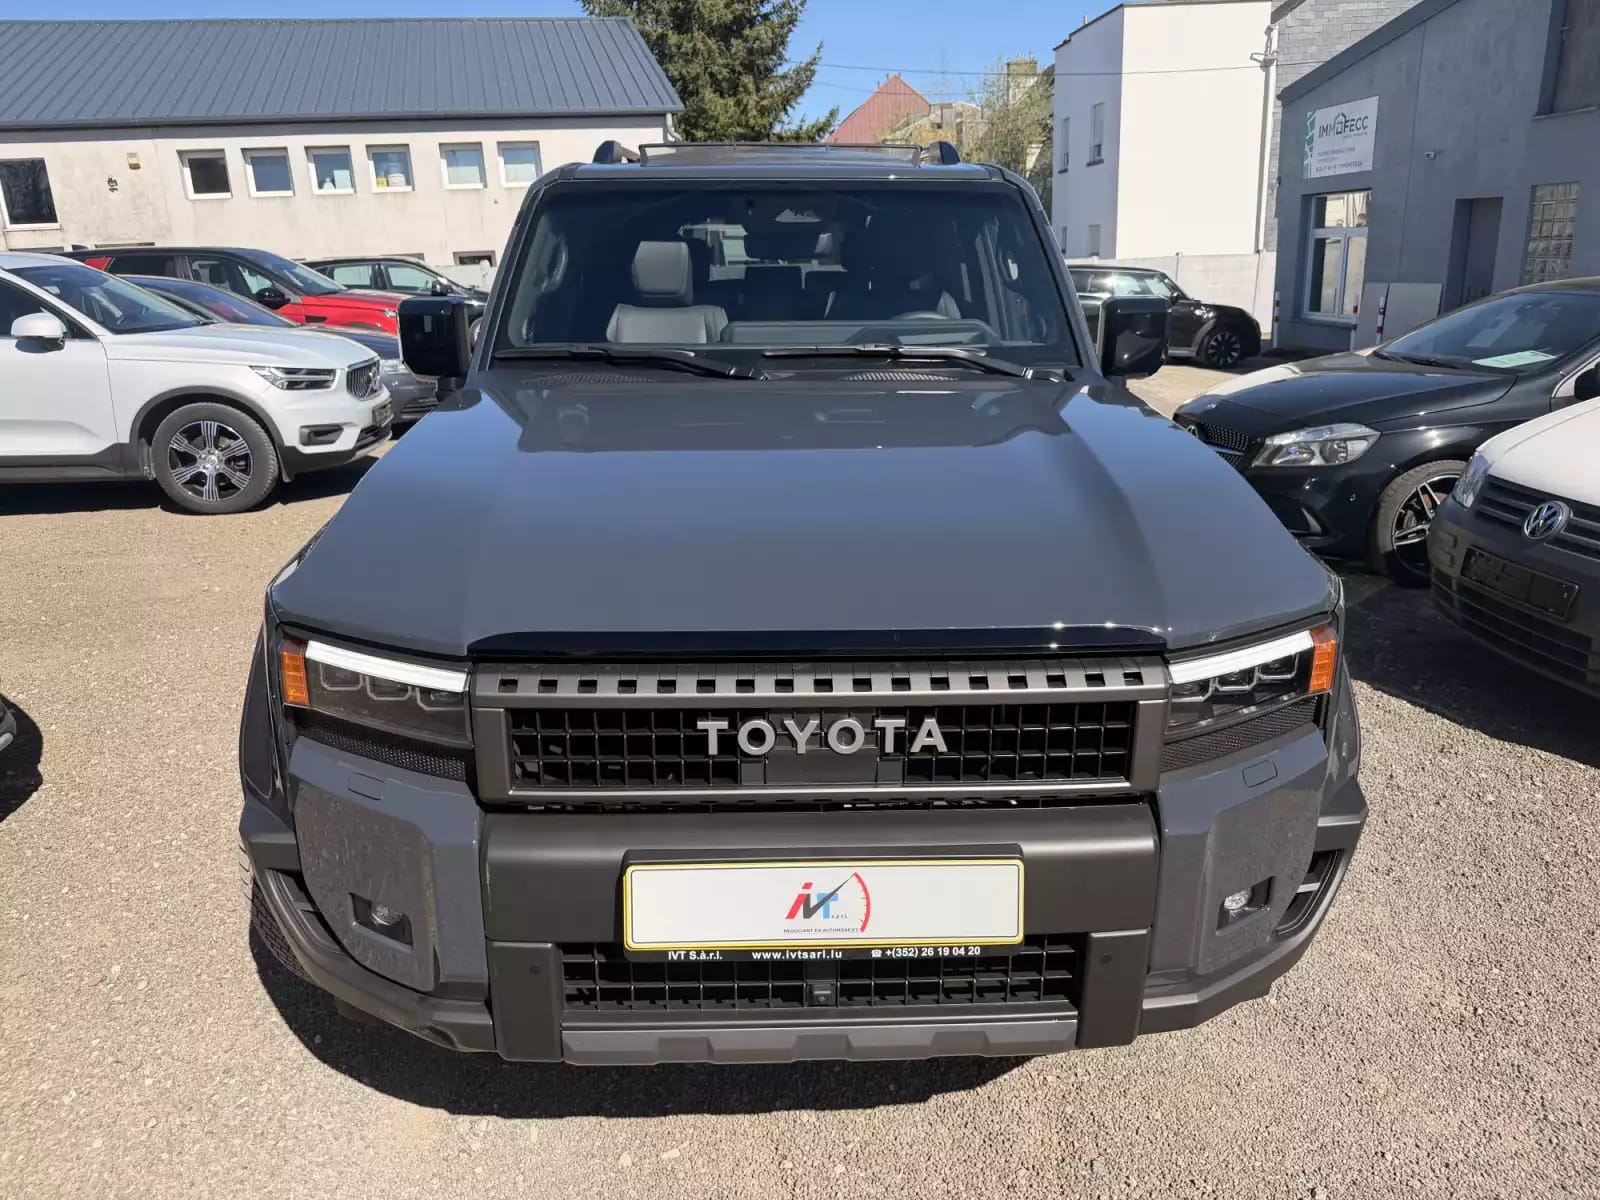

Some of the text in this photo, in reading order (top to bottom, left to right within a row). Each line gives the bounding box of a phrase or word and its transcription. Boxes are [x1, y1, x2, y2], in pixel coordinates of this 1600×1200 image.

[696, 717, 949, 756] TOYOTA
[668, 951, 686, 960] IVT
[752, 949, 843, 960] www.ivtsarl.lu
[885, 945, 981, 958] +(352) 26 19 04 20
